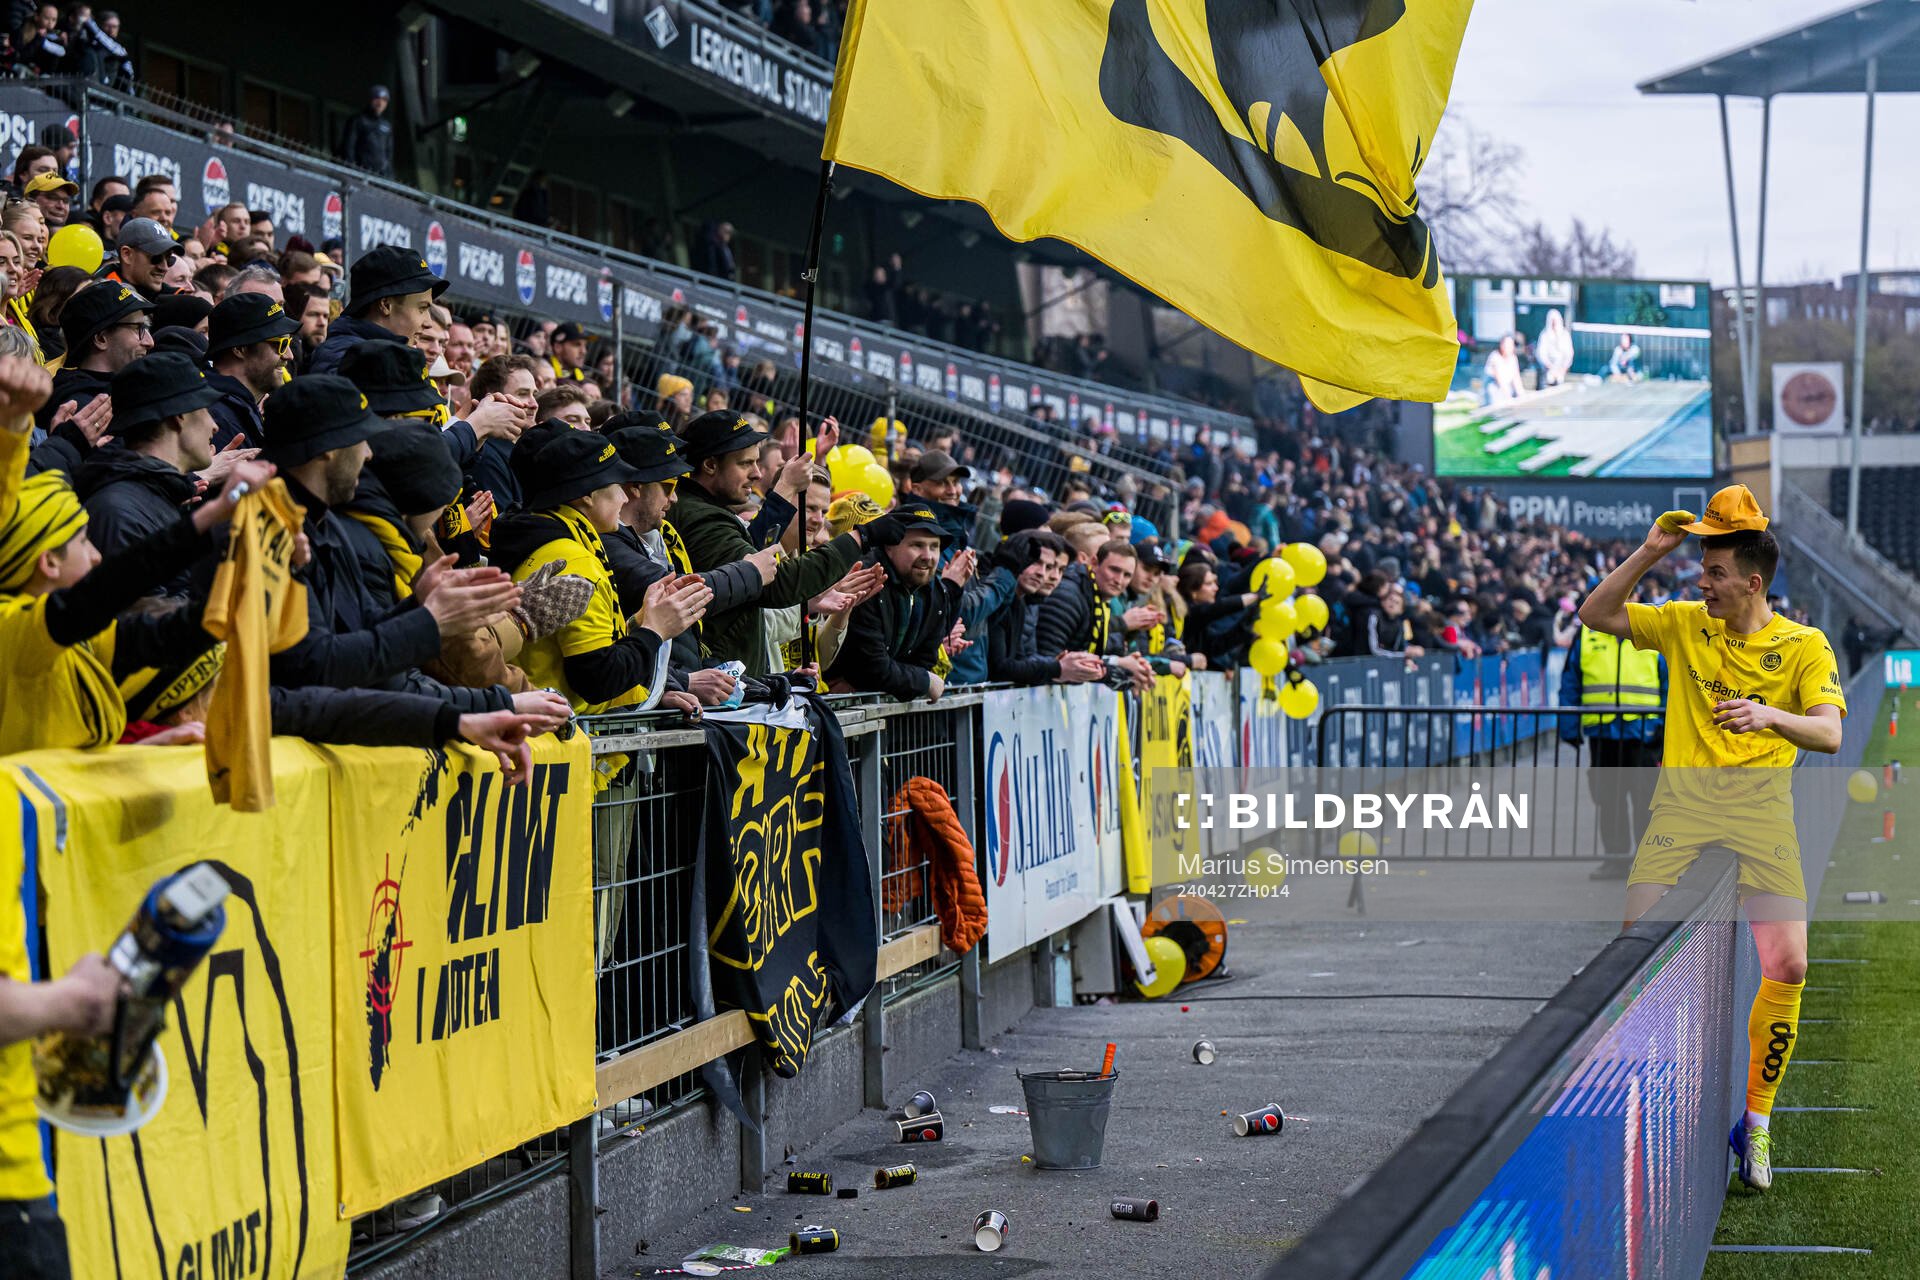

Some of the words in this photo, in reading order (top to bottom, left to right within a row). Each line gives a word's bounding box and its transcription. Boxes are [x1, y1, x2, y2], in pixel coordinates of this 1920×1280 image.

[690, 22, 782, 105] LERKENDAL
[0, 111, 35, 158] PSI
[114, 144, 182, 200] PEPSI
[247, 182, 306, 235] PEPSI
[360, 213, 412, 251] PEPSI
[459, 241, 505, 287] PEPSI
[1508, 495, 1570, 526] PPM
[1572, 500, 1653, 530] Prosjekt
[1645, 834, 1675, 848] LNS
[1762, 1022, 1796, 1083] coop
